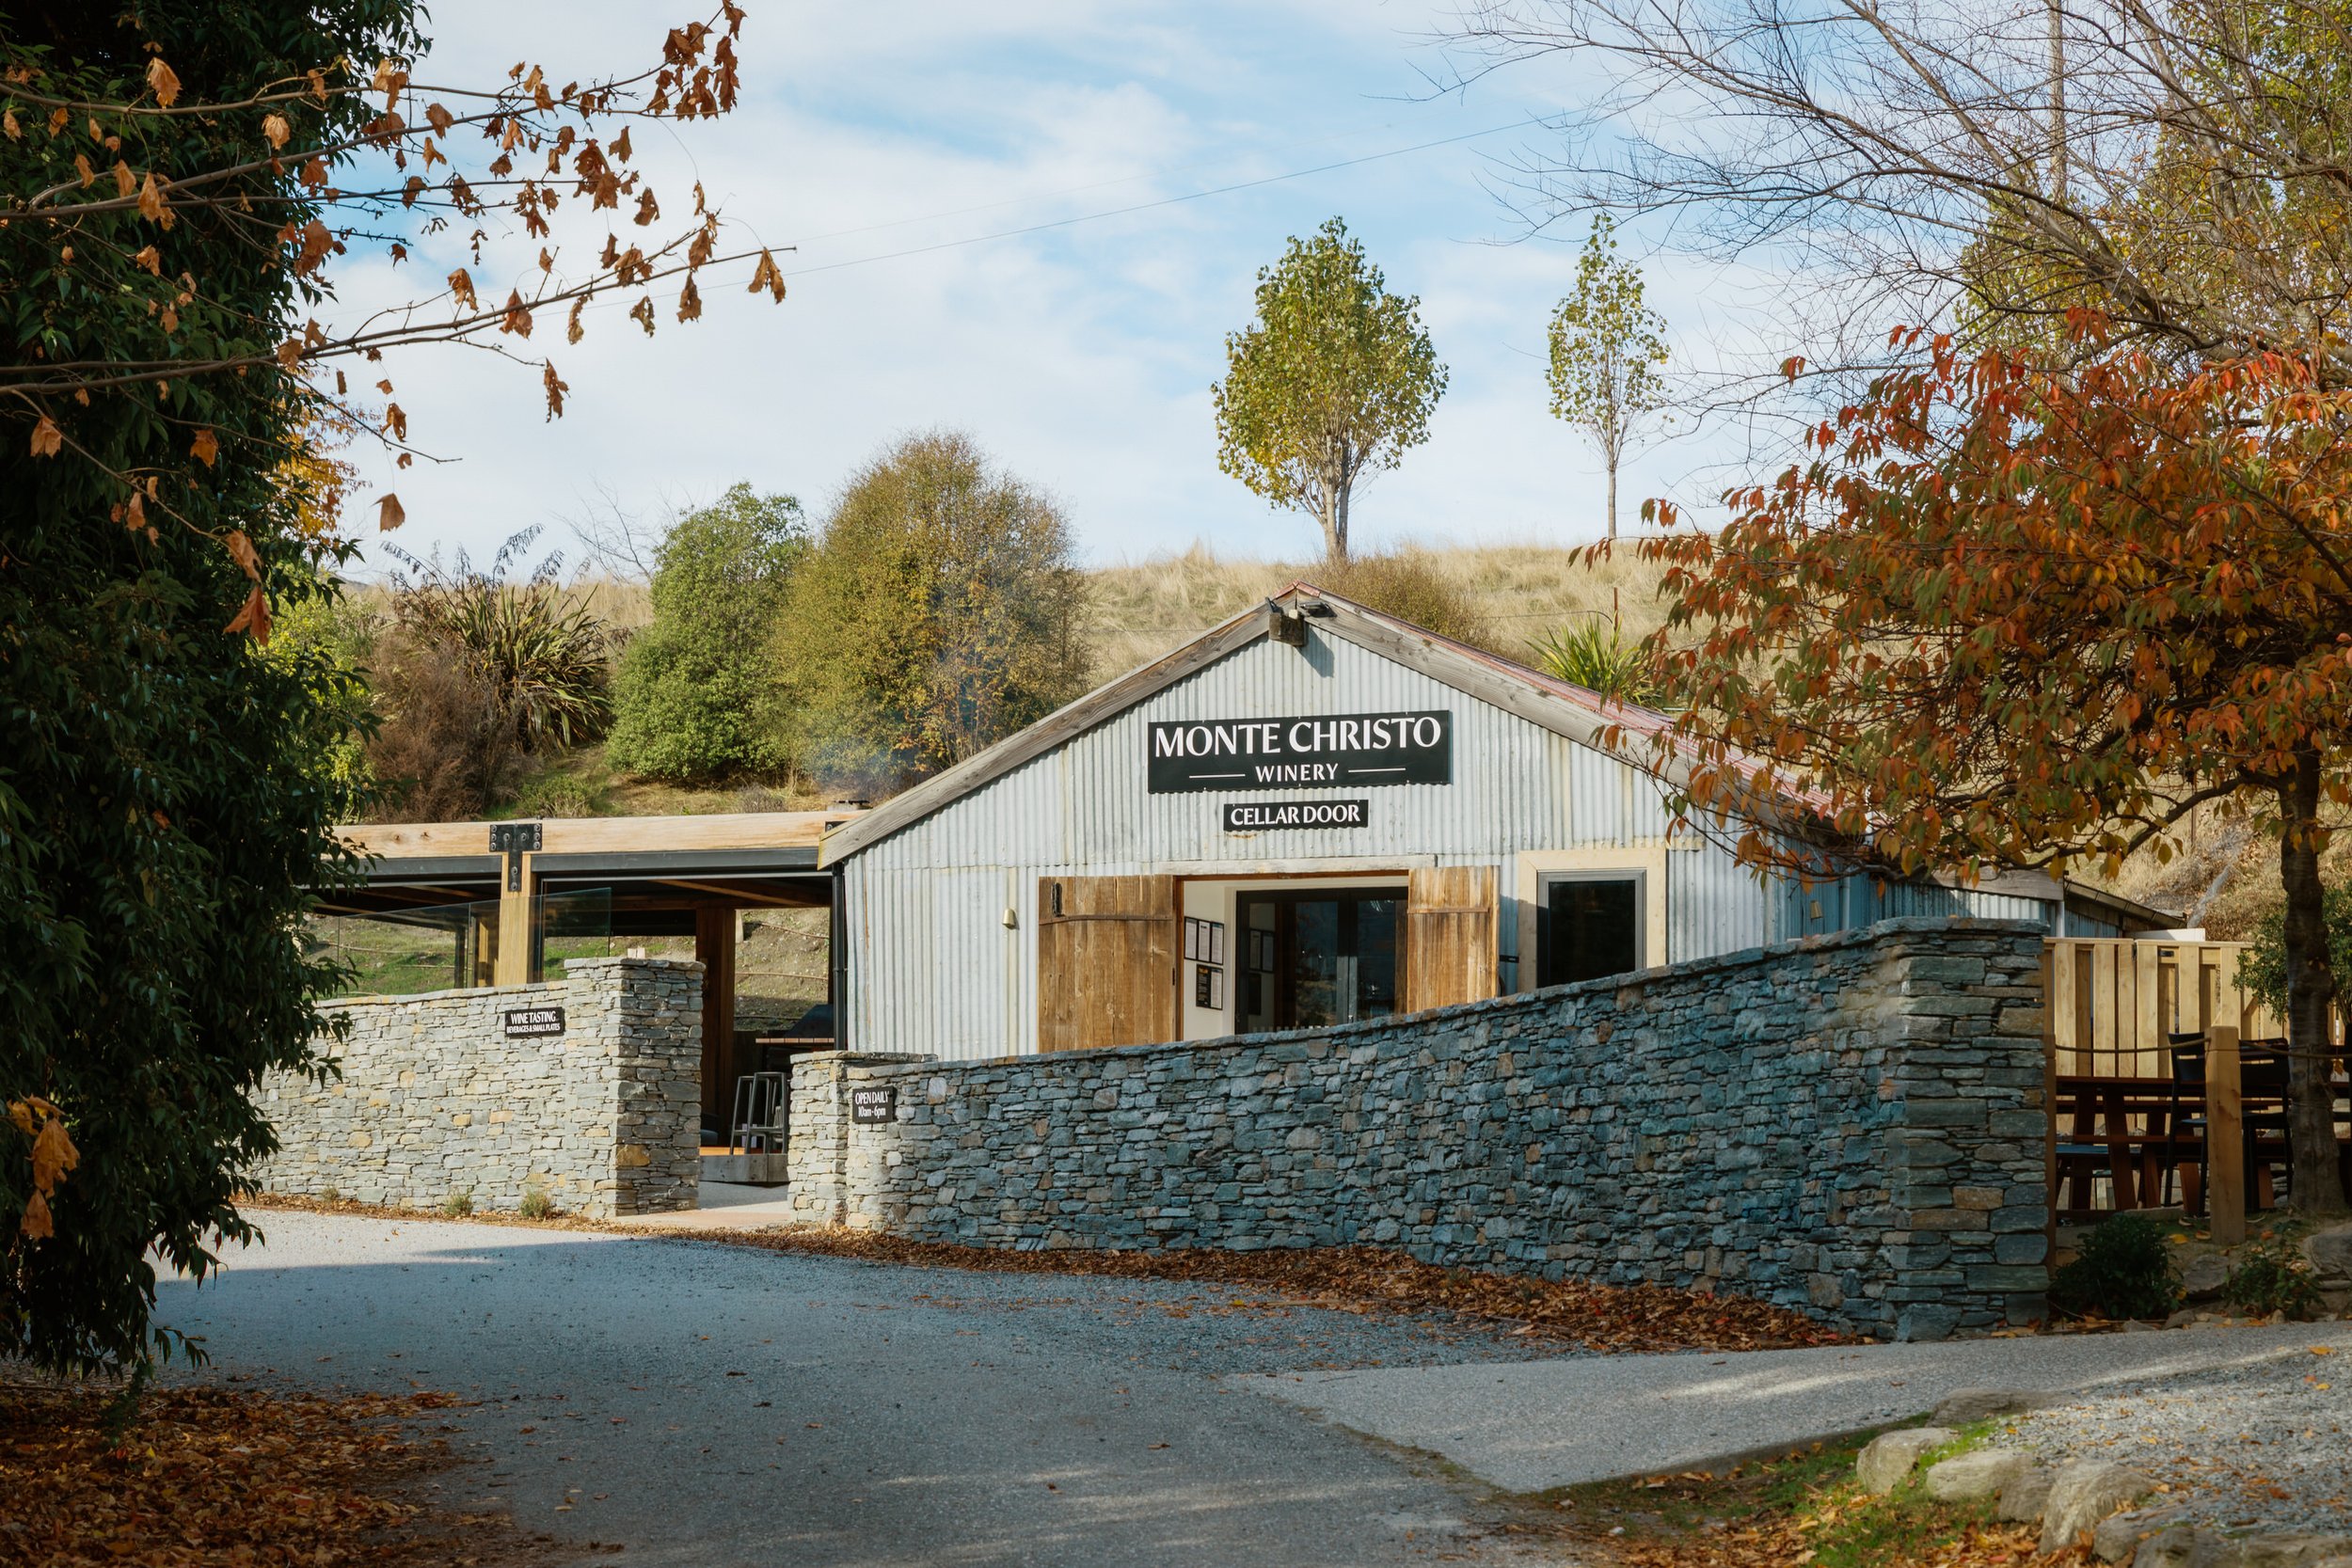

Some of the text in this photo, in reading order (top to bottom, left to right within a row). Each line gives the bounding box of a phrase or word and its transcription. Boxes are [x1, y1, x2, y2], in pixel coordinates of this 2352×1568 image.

[1154, 717, 1441, 757] MONTE CHRISTO
[1255, 763, 1339, 783] WINERY
[1231, 804, 1360, 826] CELLAR DOOR
[511, 1010, 556, 1024] WINE TASTING
[855, 1090, 890, 1104] OPEN DAILY
